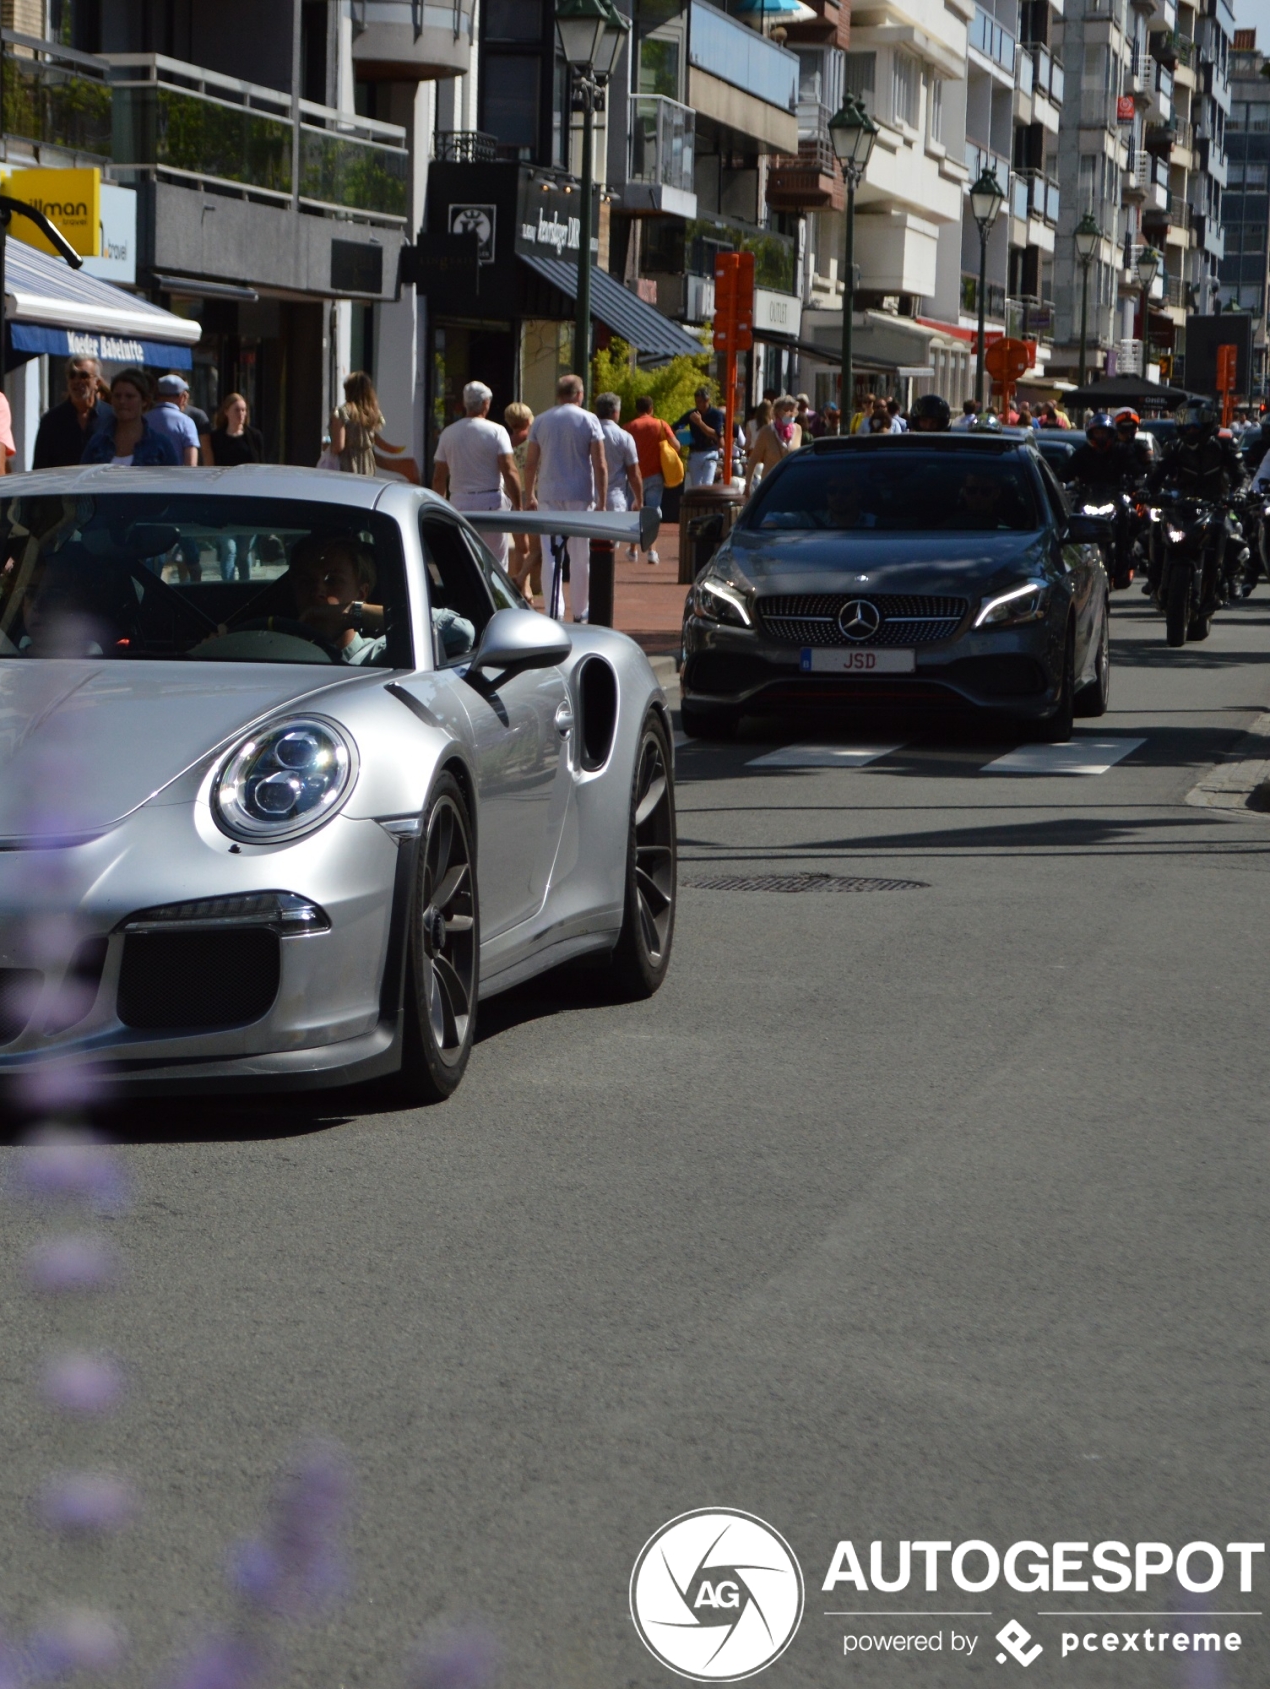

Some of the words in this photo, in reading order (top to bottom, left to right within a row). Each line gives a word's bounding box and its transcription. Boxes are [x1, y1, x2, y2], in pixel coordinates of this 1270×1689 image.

[770, 301, 788, 323] OUTLET
[67, 330, 99, 356] Moeder
[100, 335, 145, 362] Babelutte
[844, 653, 876, 669] JSD
